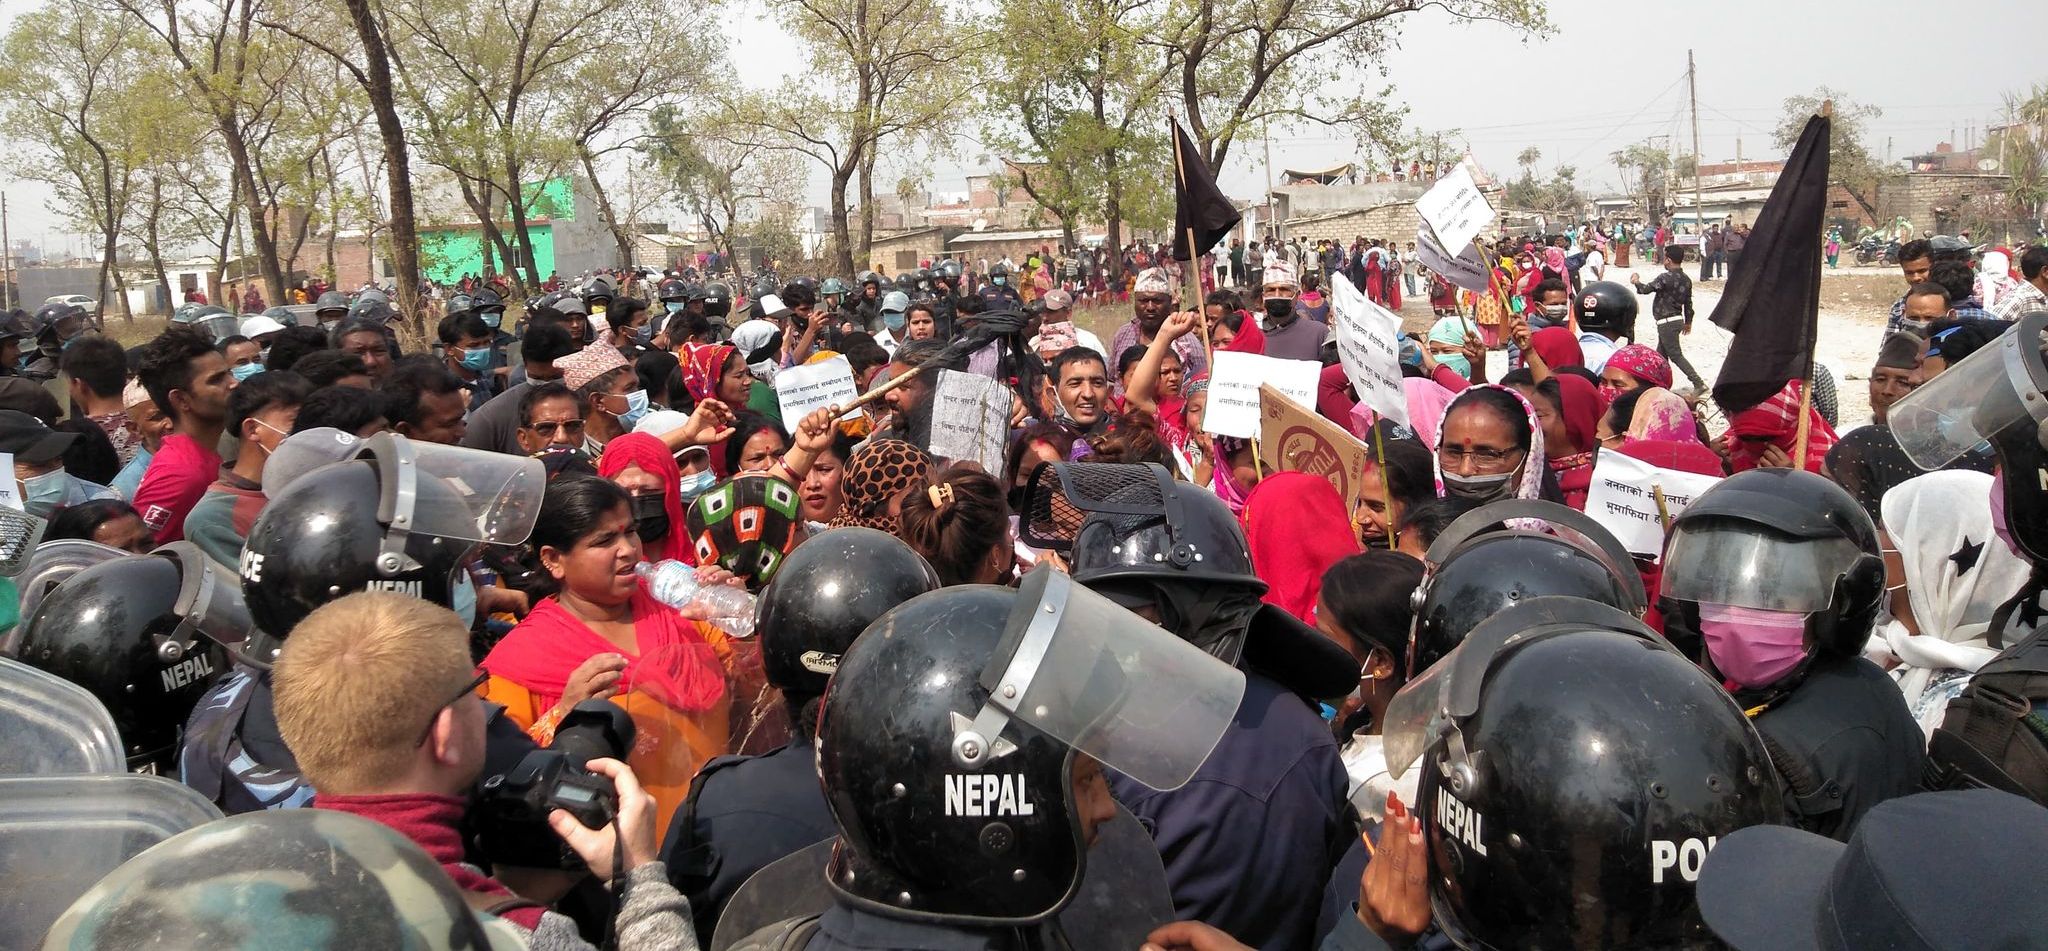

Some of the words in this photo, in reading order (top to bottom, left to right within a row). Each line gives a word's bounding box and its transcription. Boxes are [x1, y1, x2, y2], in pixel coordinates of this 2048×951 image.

[1605, 478, 1643, 497] जनताको
[1606, 501, 1650, 522] भुमाफिया
[160, 652, 214, 693] NEPAL
[945, 774, 1034, 816] NEPAL
[1437, 784, 1487, 857] NEPAL
[1651, 836, 1717, 883] PO
